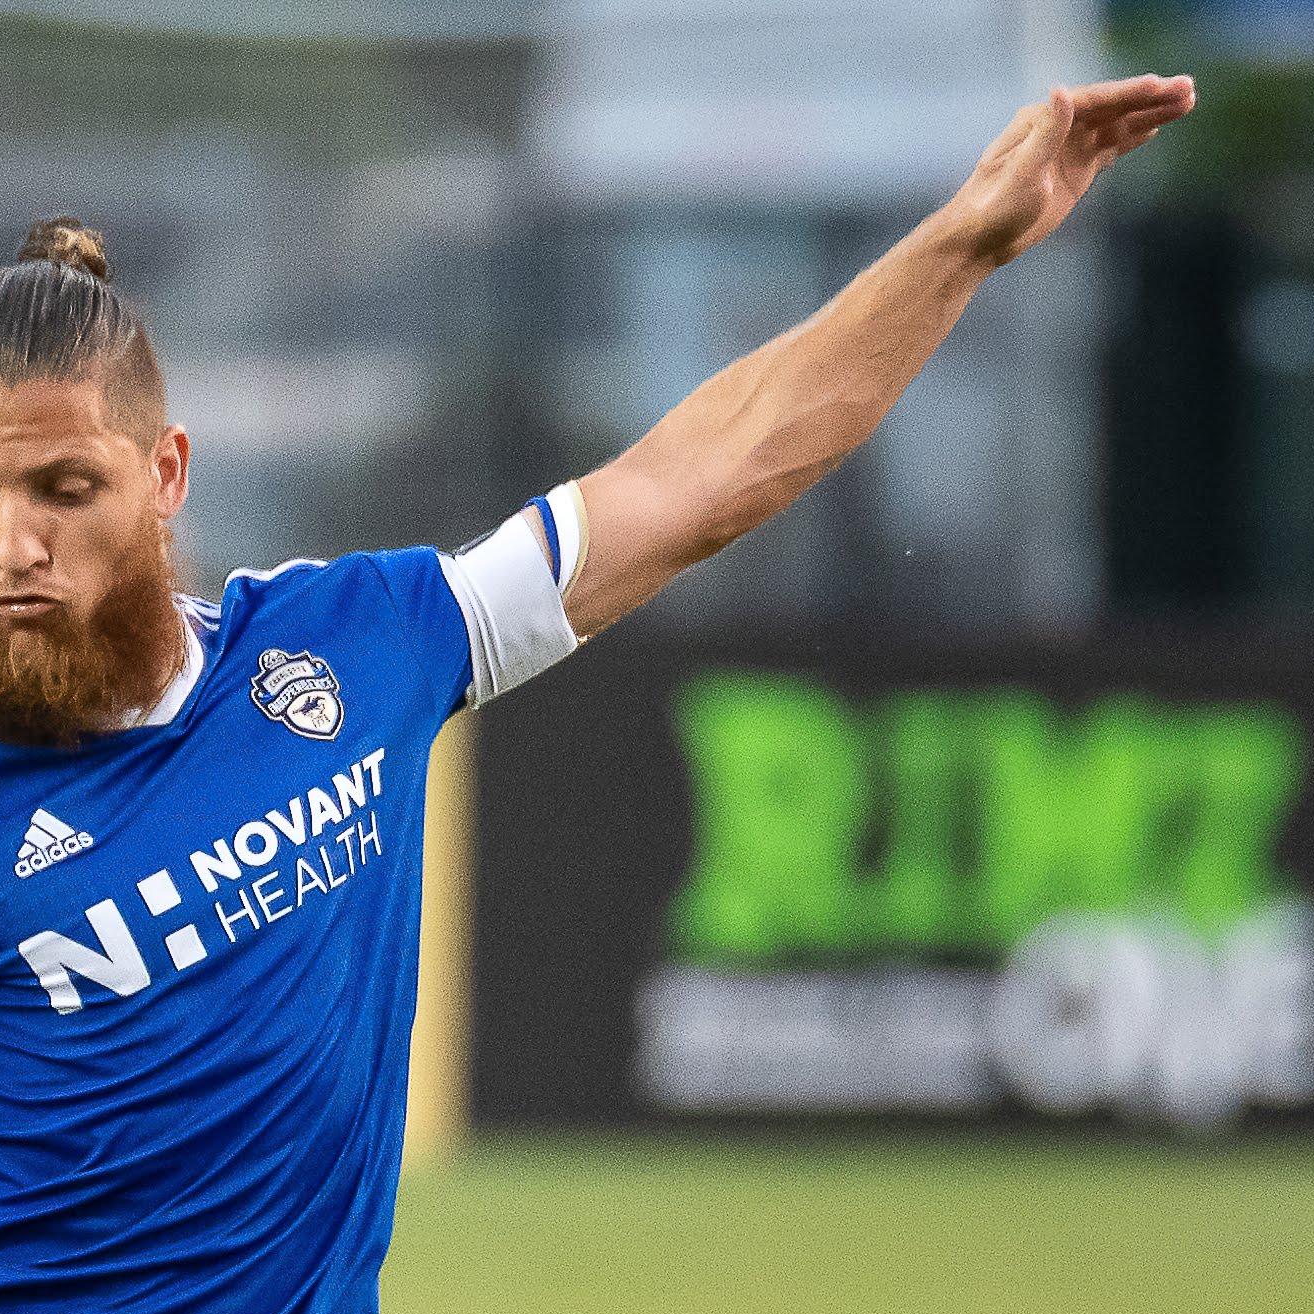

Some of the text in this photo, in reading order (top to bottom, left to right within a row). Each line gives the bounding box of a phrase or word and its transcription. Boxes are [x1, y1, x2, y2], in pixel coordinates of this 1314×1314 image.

[14, 829, 95, 880] adidas
[189, 747, 386, 893] NOVANT
[214, 810, 383, 944] HEALTH
